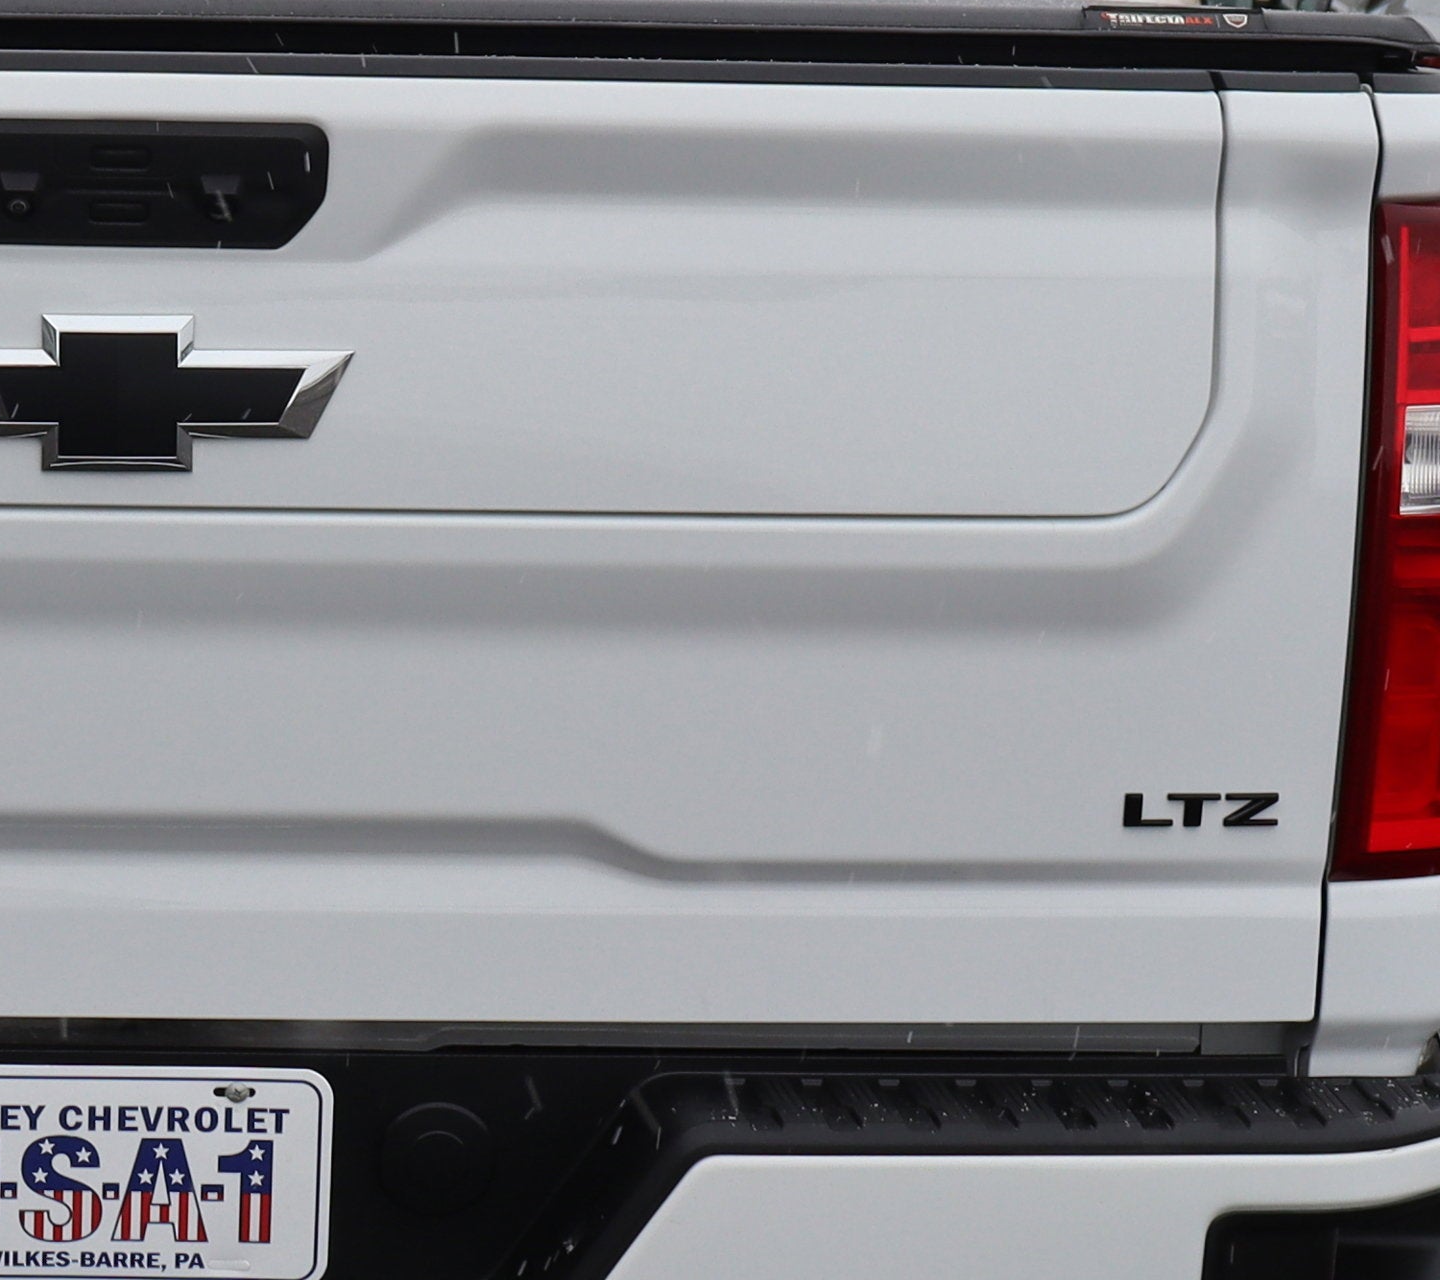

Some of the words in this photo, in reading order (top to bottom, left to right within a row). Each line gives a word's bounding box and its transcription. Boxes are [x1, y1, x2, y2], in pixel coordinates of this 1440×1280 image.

[1122, 792, 1280, 828] LTZ
[58, 1105, 291, 1135] CHEVROLET
[174, 1252, 206, 1270] PA
